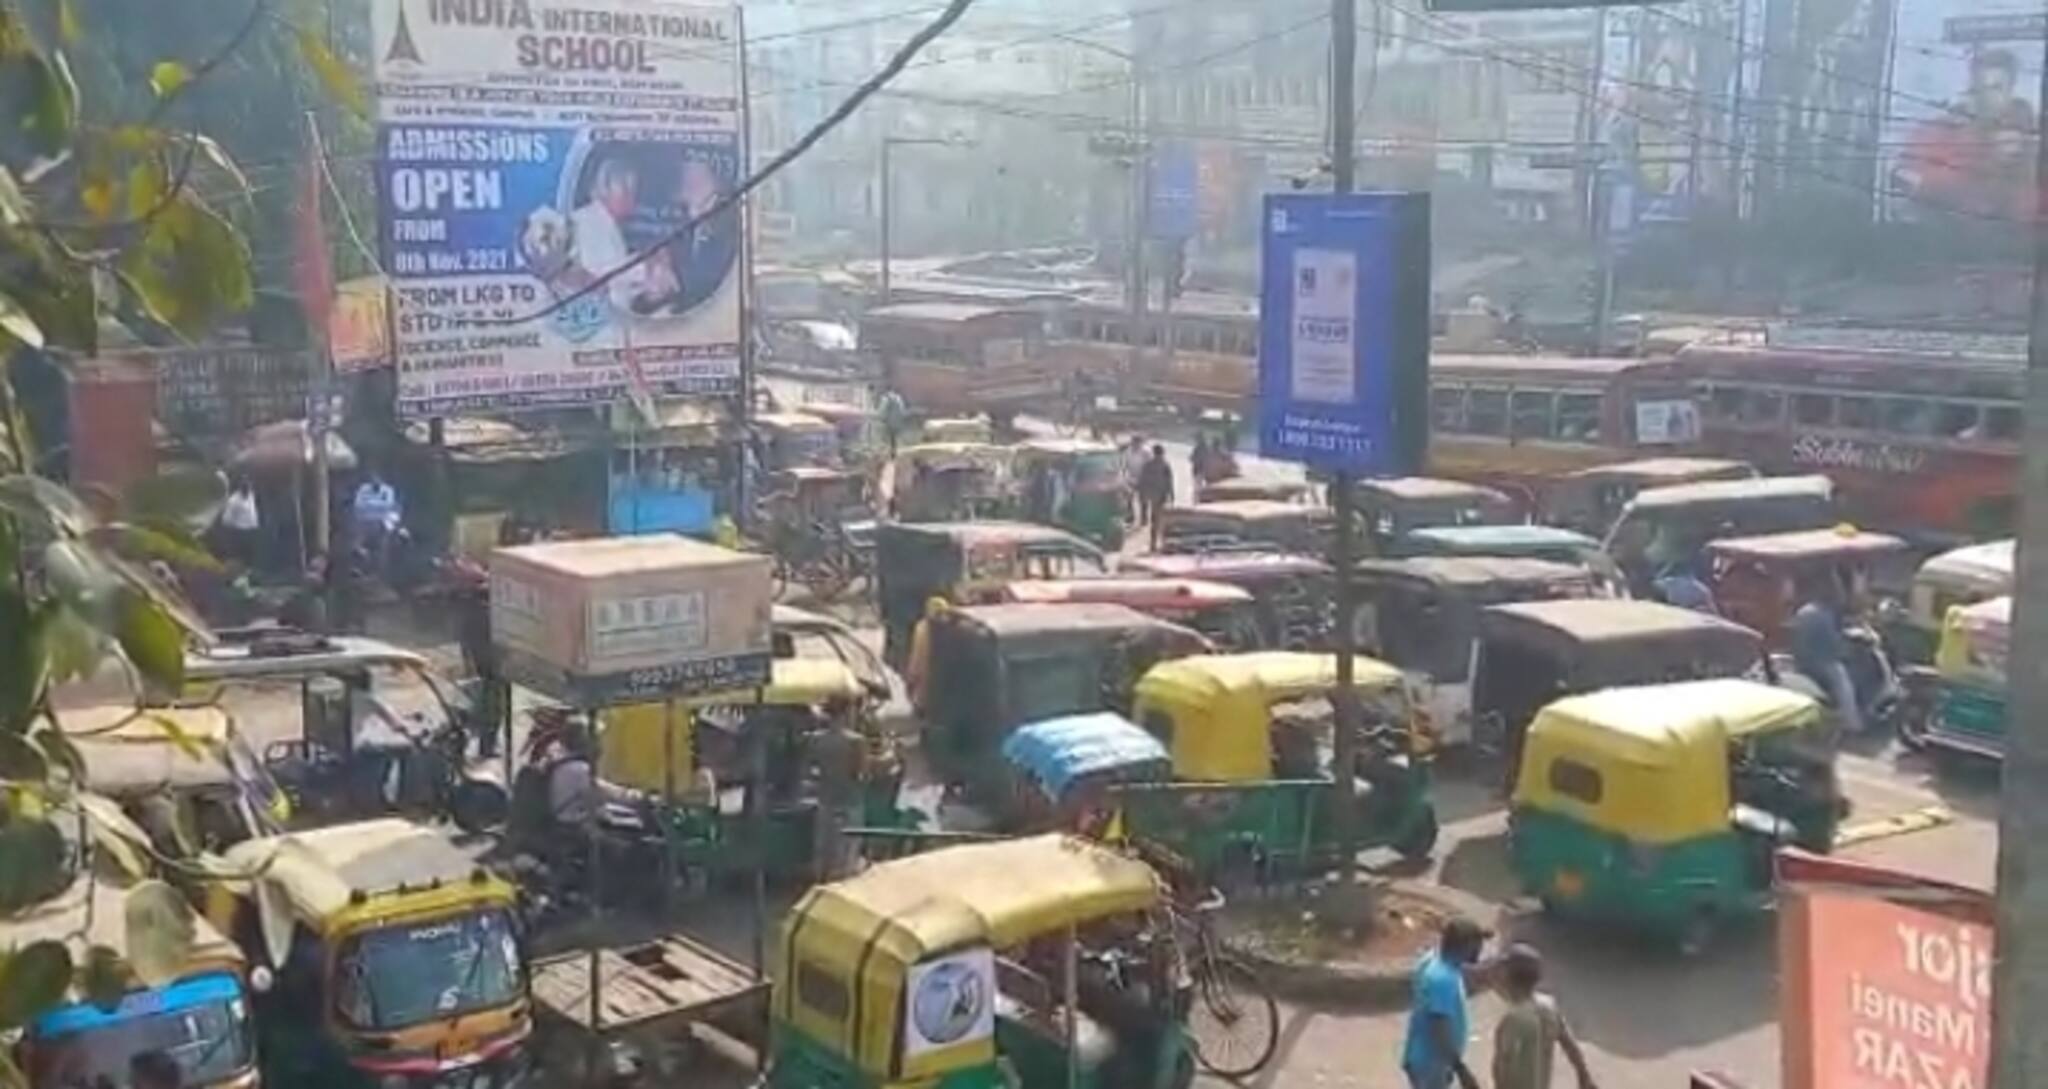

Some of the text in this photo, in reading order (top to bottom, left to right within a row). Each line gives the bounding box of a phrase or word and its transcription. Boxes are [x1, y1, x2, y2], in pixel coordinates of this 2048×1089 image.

[429, 0, 728, 41] INDIA INTERNATIONAL
[516, 34, 656, 73] SCHOOL
[391, 167, 502, 211] OPEN
[393, 219, 446, 242] FROM
[466, 250, 507, 270] 2021
[399, 284, 535, 309] FROM LKG TO
[400, 312, 442, 333] STD
